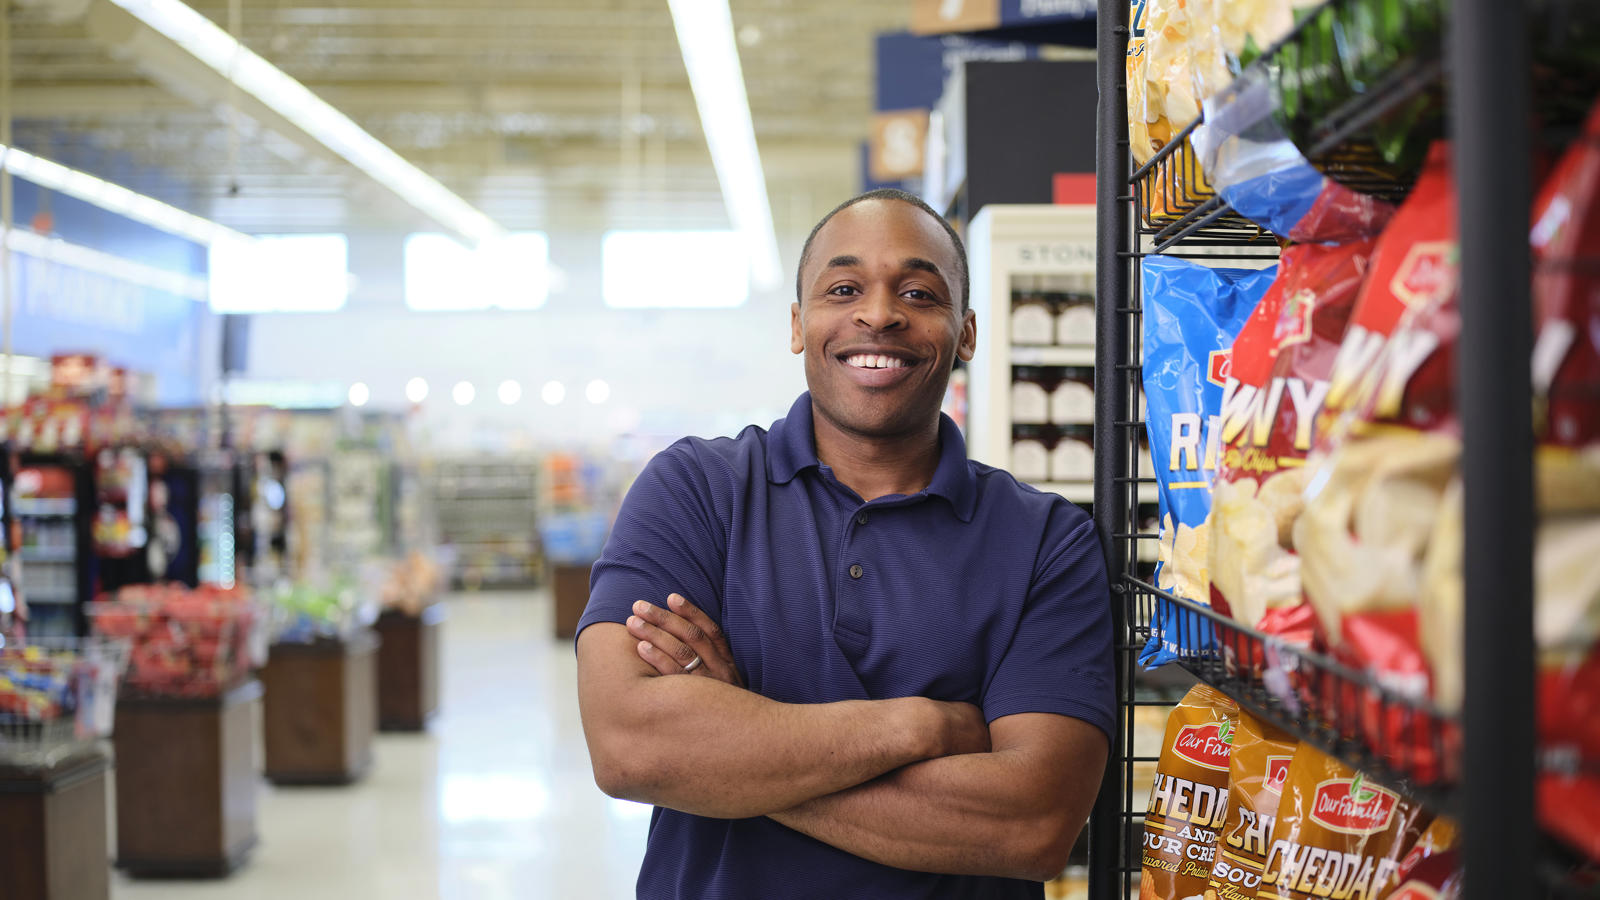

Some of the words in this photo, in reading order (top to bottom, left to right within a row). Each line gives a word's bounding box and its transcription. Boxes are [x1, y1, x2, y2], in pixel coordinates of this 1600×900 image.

[1180, 733, 1204, 750] Our
[1319, 792, 1340, 814] Our
[1337, 794, 1389, 822] Family
[1176, 826, 1216, 844] AND
